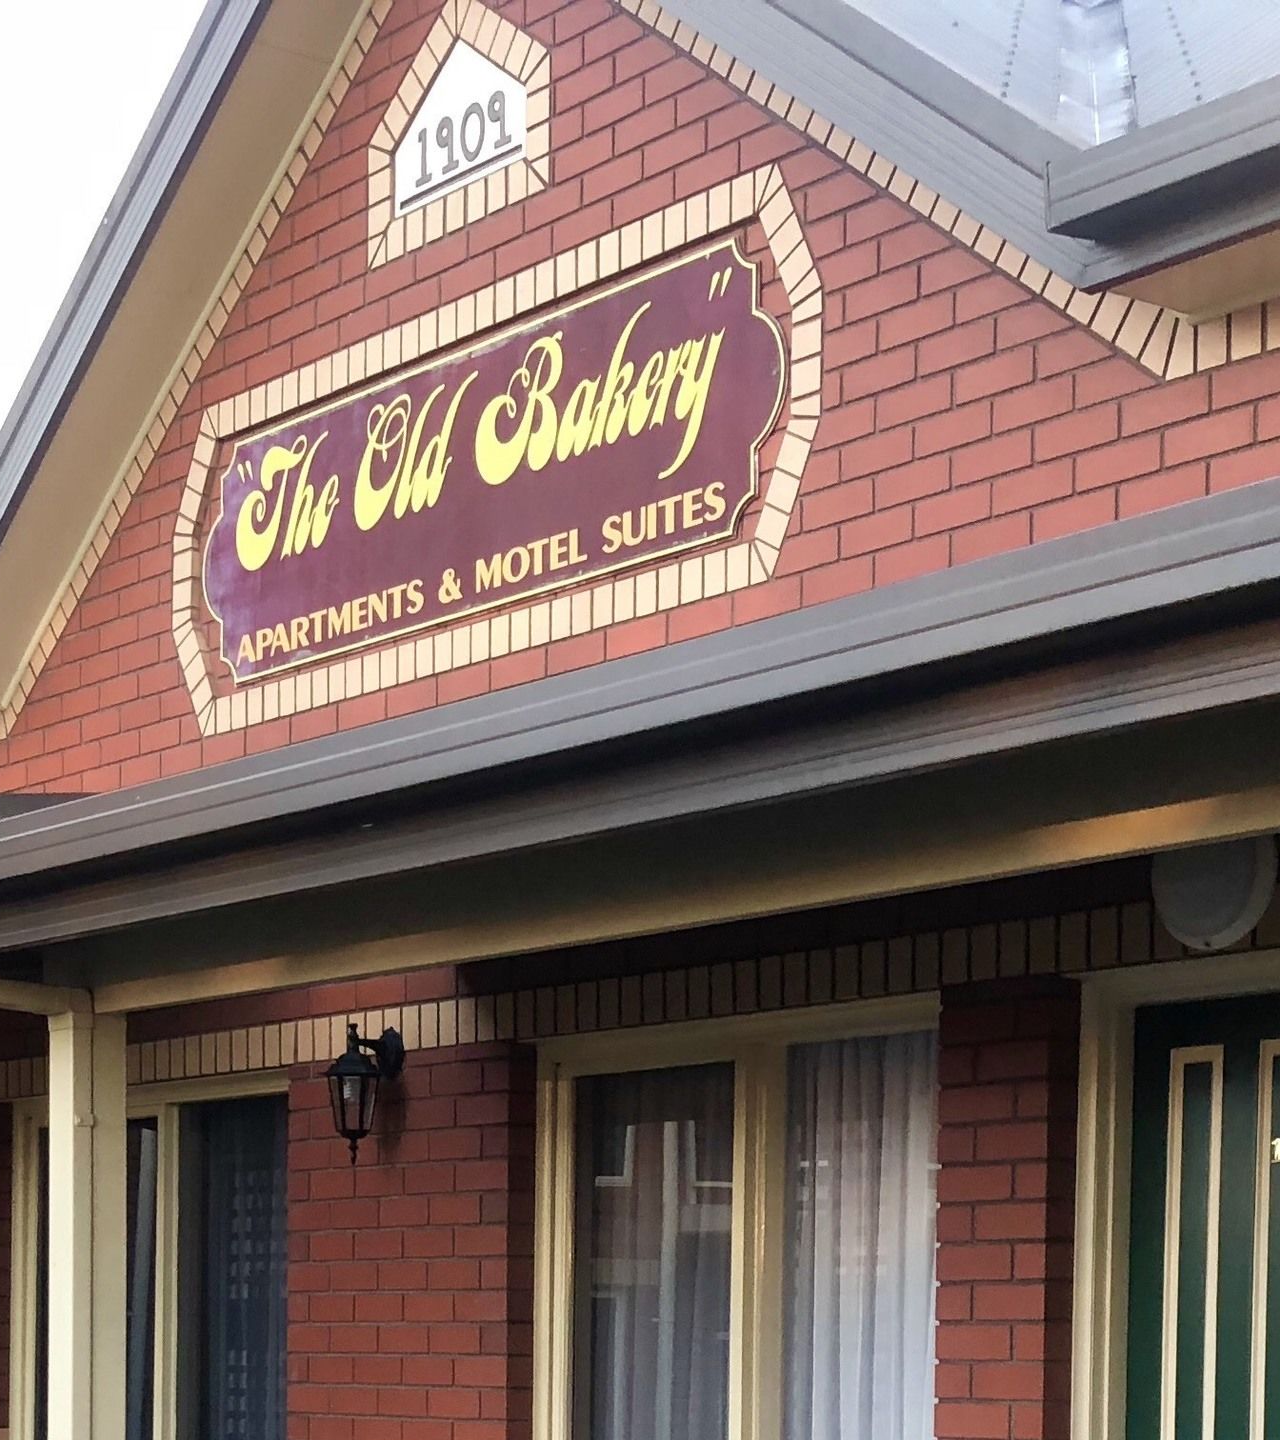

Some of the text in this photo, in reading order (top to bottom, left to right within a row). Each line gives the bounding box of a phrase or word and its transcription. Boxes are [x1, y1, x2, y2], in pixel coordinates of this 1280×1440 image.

[415, 90, 512, 188] 1909
[353, 370, 479, 531] Old
[236, 481, 726, 668] APARTMENTS & MOTEL SUITES
